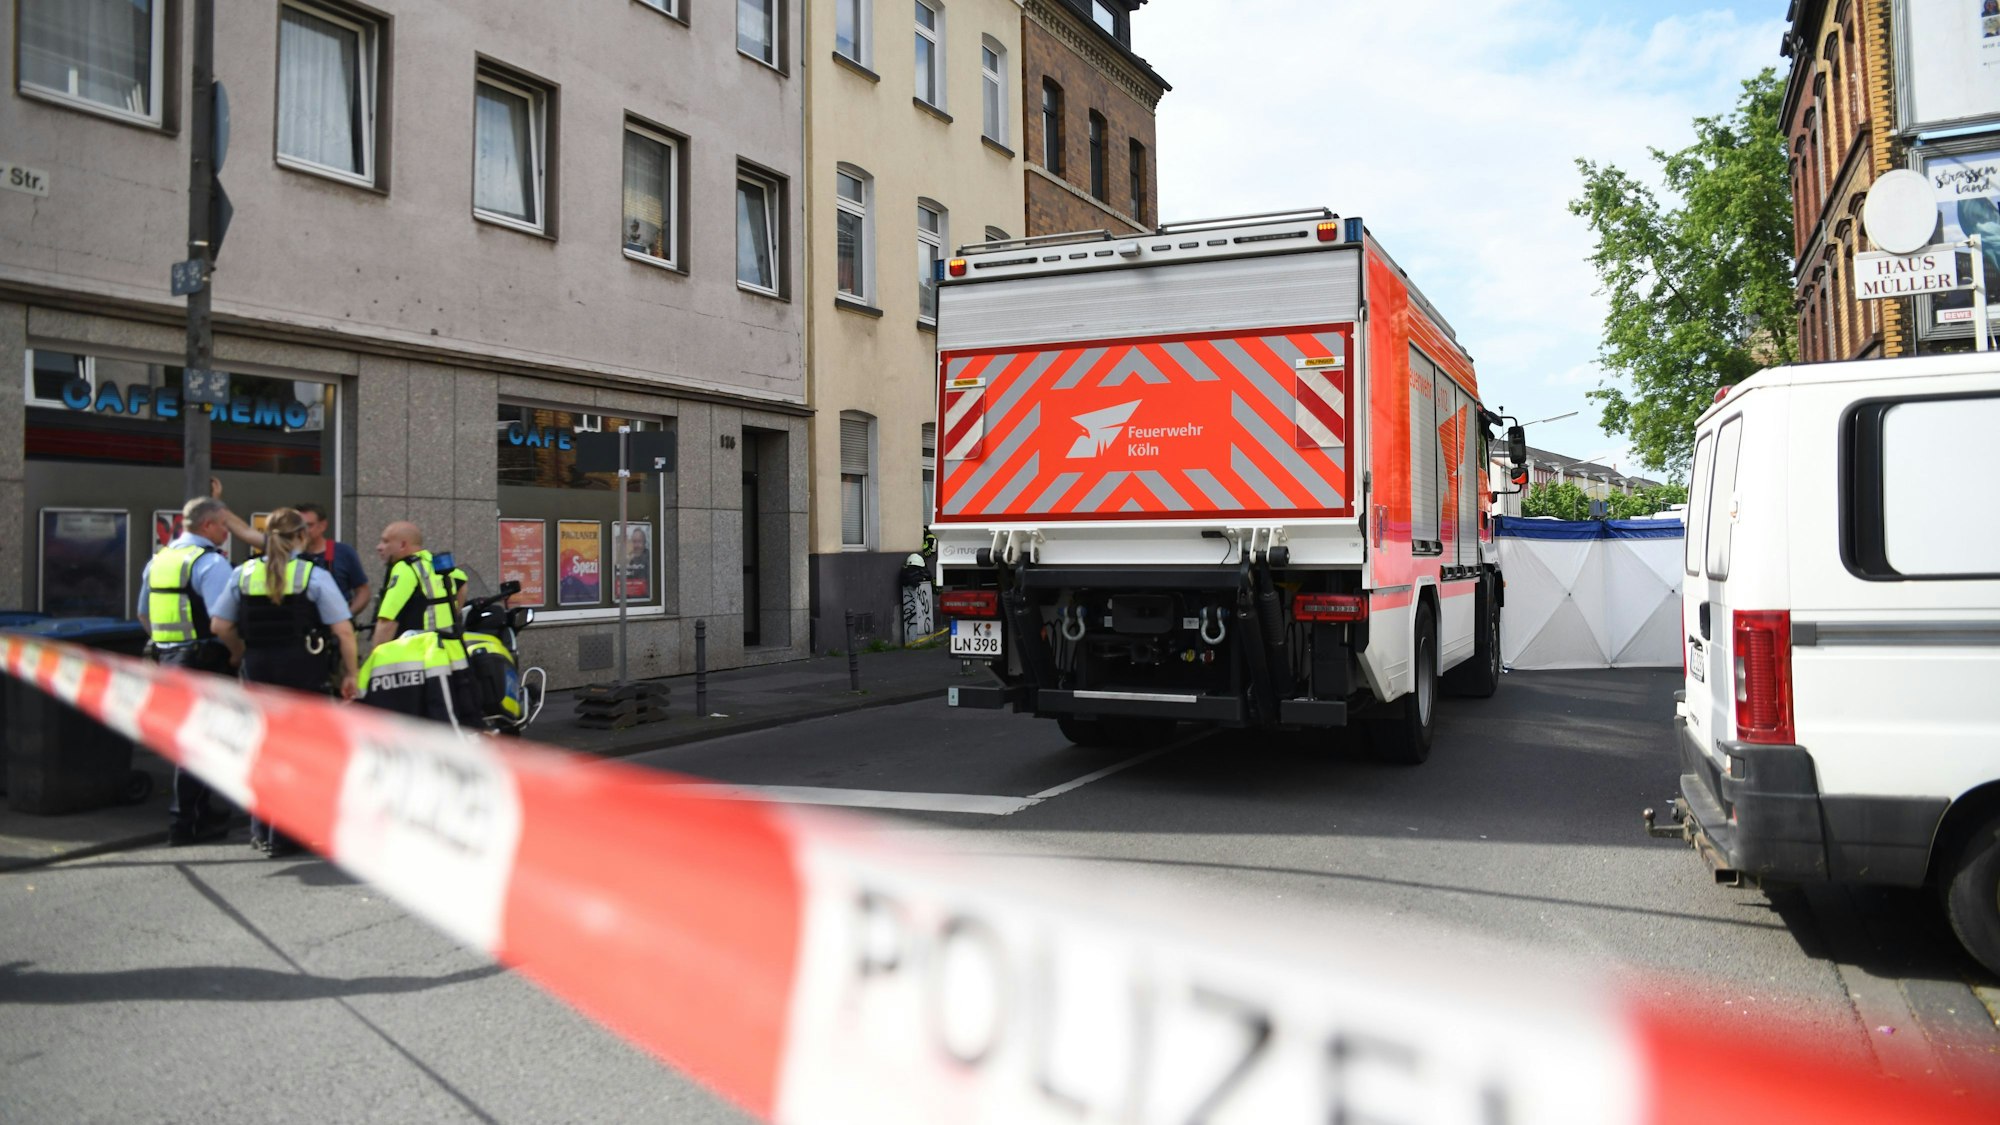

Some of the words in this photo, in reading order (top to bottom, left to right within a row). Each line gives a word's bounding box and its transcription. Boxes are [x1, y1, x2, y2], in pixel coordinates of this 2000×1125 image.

[10, 167, 44, 191] Str.
[1956, 178, 1991, 194] land
[1877, 255, 1936, 275] HAUS
[1863, 274, 1952, 296] MÜLLER
[1944, 311, 1972, 320] REWE
[1409, 367, 1432, 401] euerwehr
[63, 378, 179, 417] CAFE
[508, 421, 573, 451] CAFE
[1128, 422, 1204, 439] Feuerwehr
[1127, 442, 1159, 457] Köln
[572, 556, 598, 577] Spezi
[973, 623, 982, 637] K
[954, 637, 971, 652] LN
[974, 638, 998, 652] 398
[371, 670, 425, 692] POLIZEI
[848, 884, 1515, 1125] POLIZ
